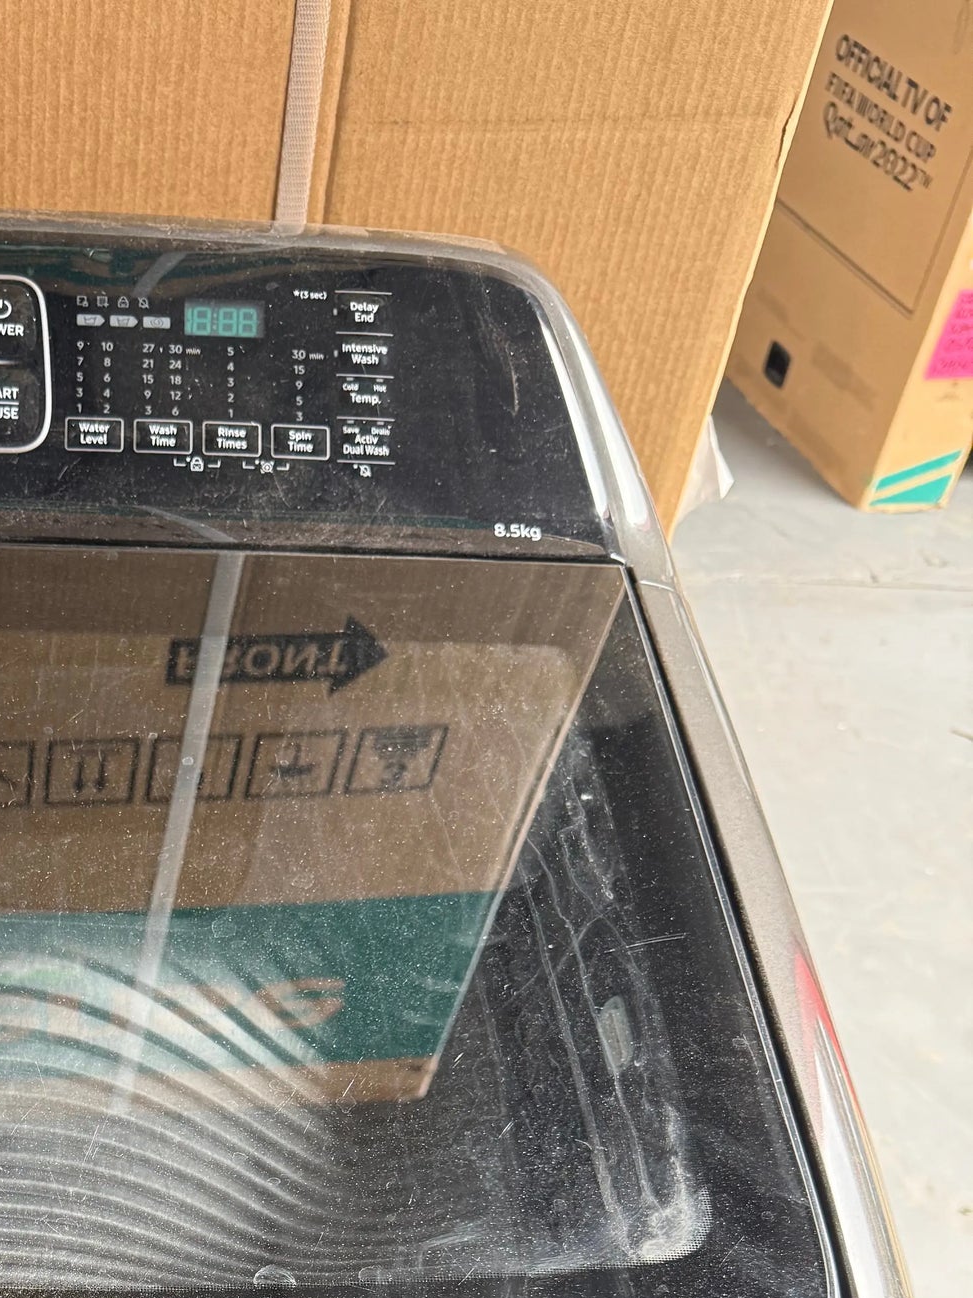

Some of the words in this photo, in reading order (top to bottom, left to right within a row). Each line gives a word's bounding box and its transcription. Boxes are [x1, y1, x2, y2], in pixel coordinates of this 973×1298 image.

[835, 34, 903, 102] OFFICIAL
[901, 77, 929, 115] TV
[924, 95, 953, 132] OF
[905, 130, 937, 163] CUP
[350, 302, 379, 314] Delay
[355, 312, 375, 323] End
[76, 341, 85, 351] 9
[101, 341, 114, 352] 10
[142, 343, 155, 353] 27
[168, 344, 183, 354] 30
[185, 347, 201, 355] min
[227, 346, 235, 356] 5
[341, 344, 388, 355] Intensive
[291, 349, 307, 360] 30
[309, 352, 325, 360] min
[351, 354, 379, 365] Wash
[76, 356, 85, 366] 7
[103, 357, 111, 368] 8
[142, 359, 155, 369] 21
[169, 360, 182, 370] 24
[227, 362, 235, 372] 4
[293, 364, 305, 375] 15
[76, 372, 84, 382] 5
[103, 373, 111, 383] 6
[142, 374, 155, 384] 15
[169, 375, 182, 386] 18
[227, 377, 235, 388] 3
[295, 380, 303, 390] 9
[342, 382, 359, 392] Cold
[75, 387, 83, 398] 3
[103, 388, 111, 398] 4
[143, 390, 151, 400] 9
[169, 390, 182, 401] 12
[227, 392, 235, 403] 2
[295, 396, 303, 406] 5
[350, 392, 381, 406] Temp.
[76, 403, 83, 414] 1
[103, 404, 111, 414] 2
[145, 406, 152, 416] 3
[171, 406, 179, 416] 6
[228, 408, 234, 418] 1
[295, 412, 303, 422] 3
[79, 422, 110, 434] Water
[148, 424, 177, 436] Wash
[217, 427, 247, 438] Rinse
[79, 434, 108, 445] Level
[289, 430, 312, 442] Spin
[355, 434, 379, 445] Activ
[150, 436, 177, 448] Time
[217, 438, 247, 450] Times
[287, 441, 313, 452] Time
[343, 444, 365, 456] Dual
[365, 444, 389, 456] Wash
[493, 522, 542, 542] 8.5kg
